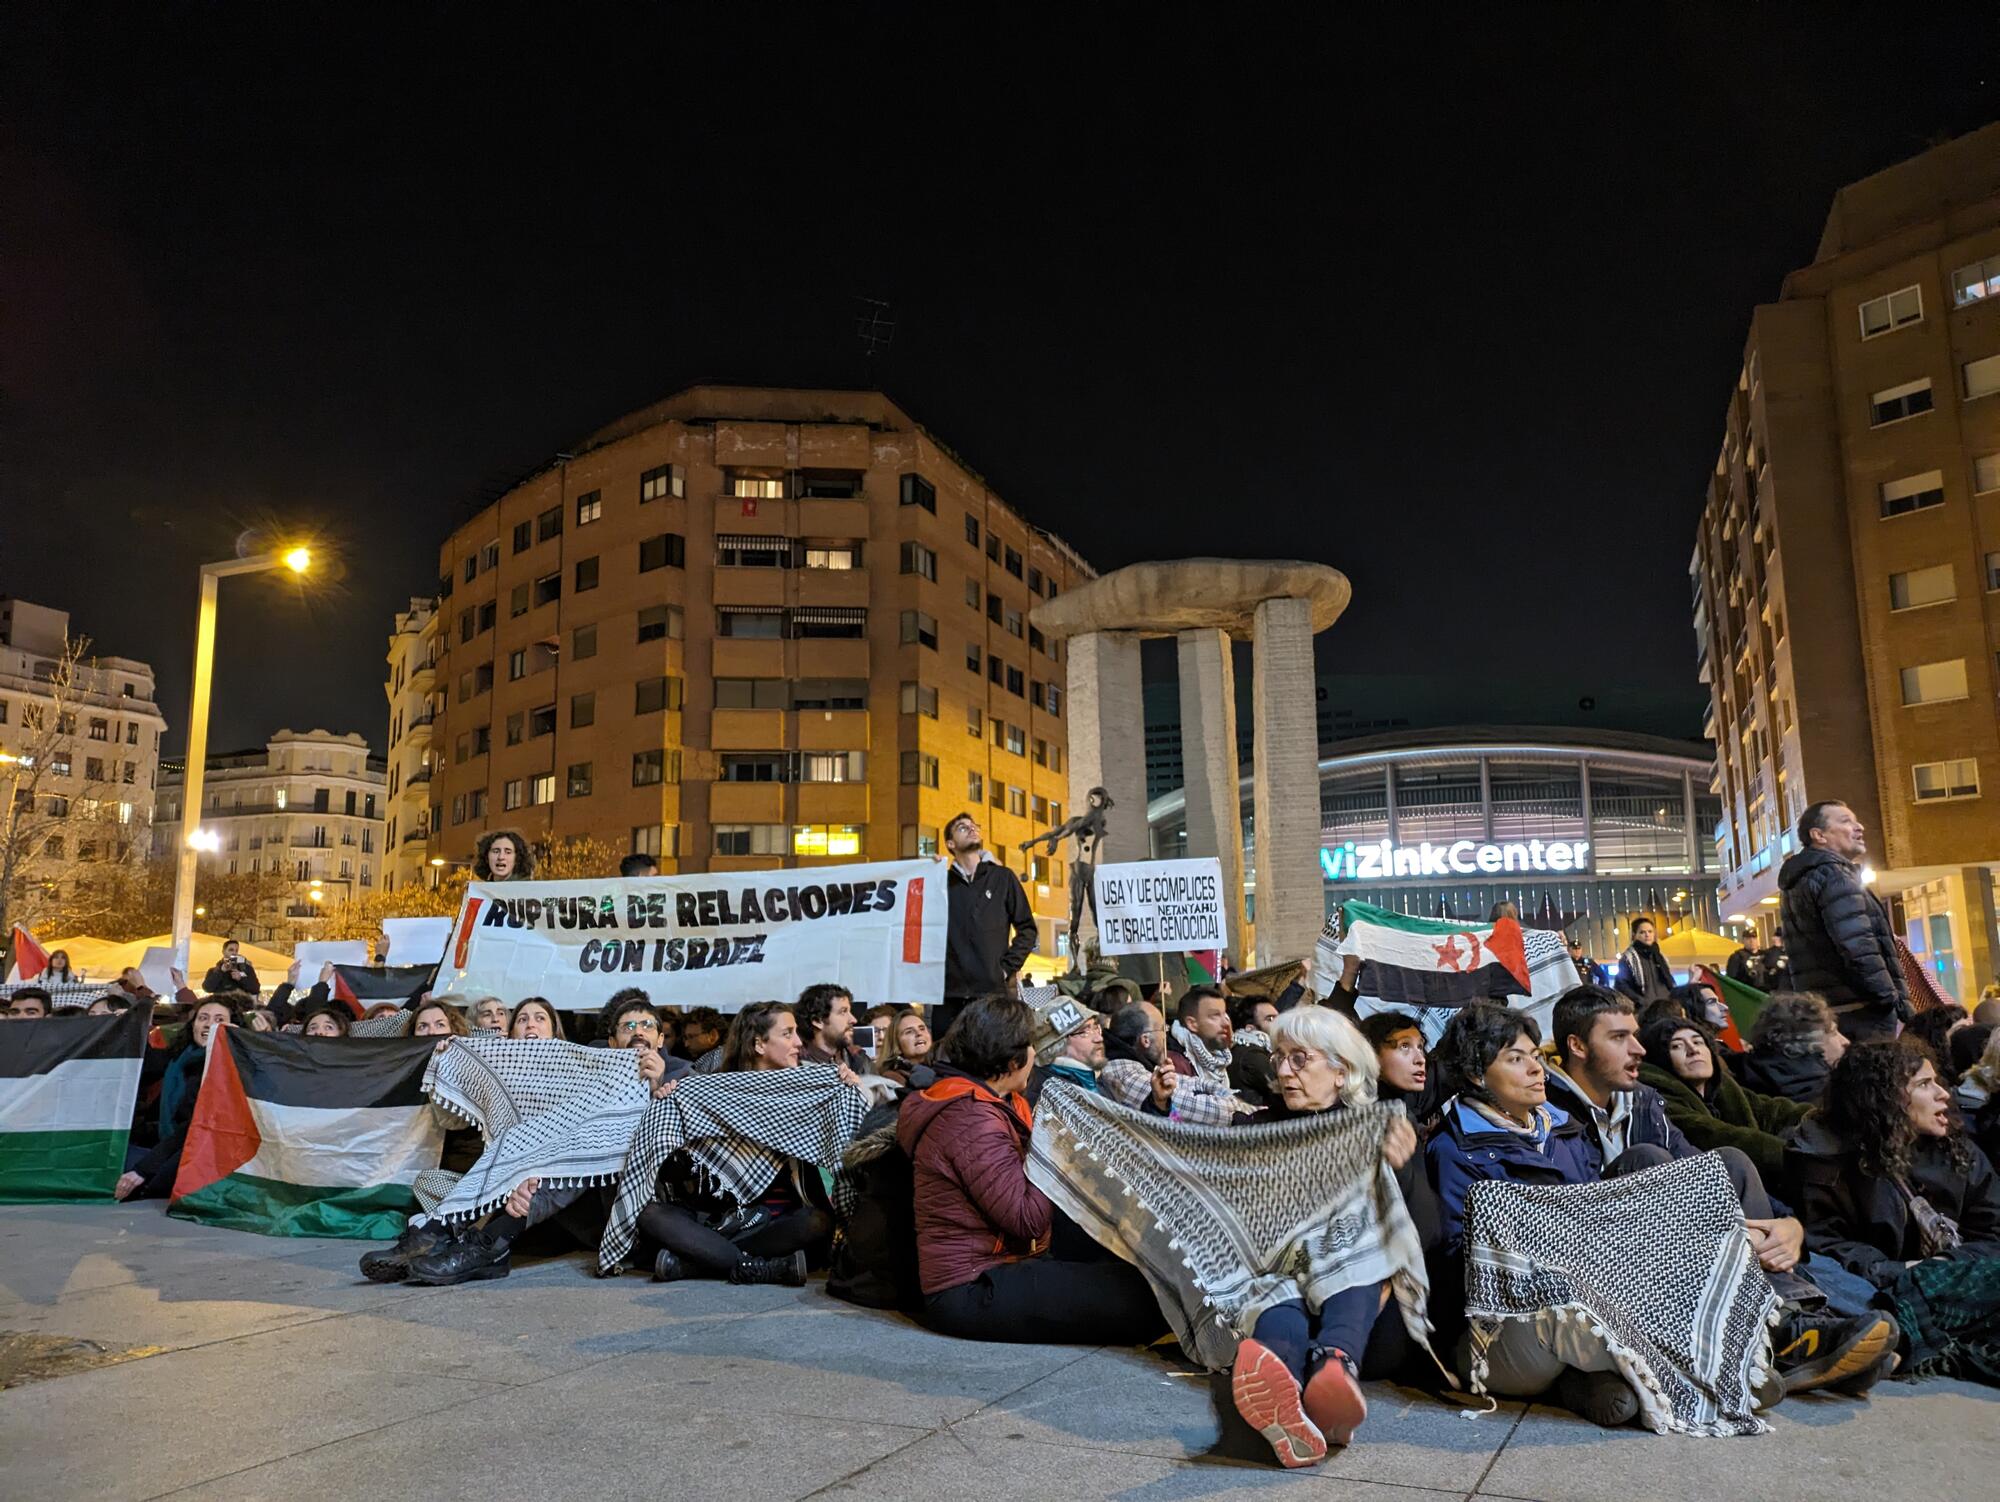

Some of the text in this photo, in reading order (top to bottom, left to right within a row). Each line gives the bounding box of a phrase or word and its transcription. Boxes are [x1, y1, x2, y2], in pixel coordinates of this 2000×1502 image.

[1102, 872, 1216, 905] USA Y UE CÓMPLICES
[482, 879, 898, 930] RUPTURA DE RELACIONES
[1158, 903, 1217, 916] NETANYAHU
[1105, 915, 1219, 944] DE ISRAEL GENOCIDA!
[579, 938, 646, 973] CON
[1049, 1002, 1081, 1031] PAZ
